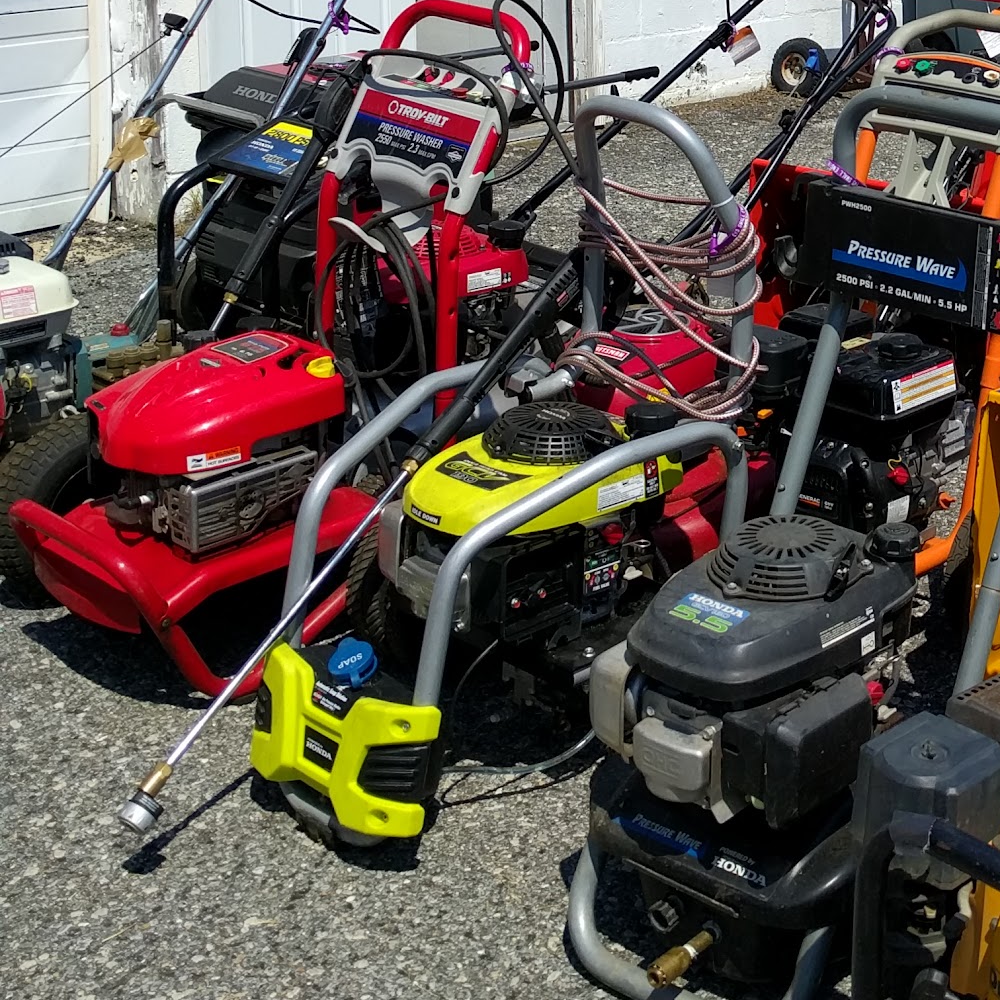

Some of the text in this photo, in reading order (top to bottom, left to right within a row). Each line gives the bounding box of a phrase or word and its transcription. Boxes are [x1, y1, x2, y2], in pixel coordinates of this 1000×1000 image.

[397, 103, 449, 128] TROY-BILT
[378, 122, 444, 150] PRESSURE WASHER
[836, 273, 858, 285] 2500
[859, 278, 874, 289] PSI
[879, 284, 894, 295] 2.2
[938, 299, 952, 310] 5.5
[954, 303, 967, 312] HP
[799, 494, 820, 504] ENERAC
[668, 604, 733, 634] 5.5
[688, 593, 745, 619] HONDA
[337, 652, 363, 670] SOAP
[306, 740, 333, 761] HONDA
[711, 855, 767, 888] HONDA
